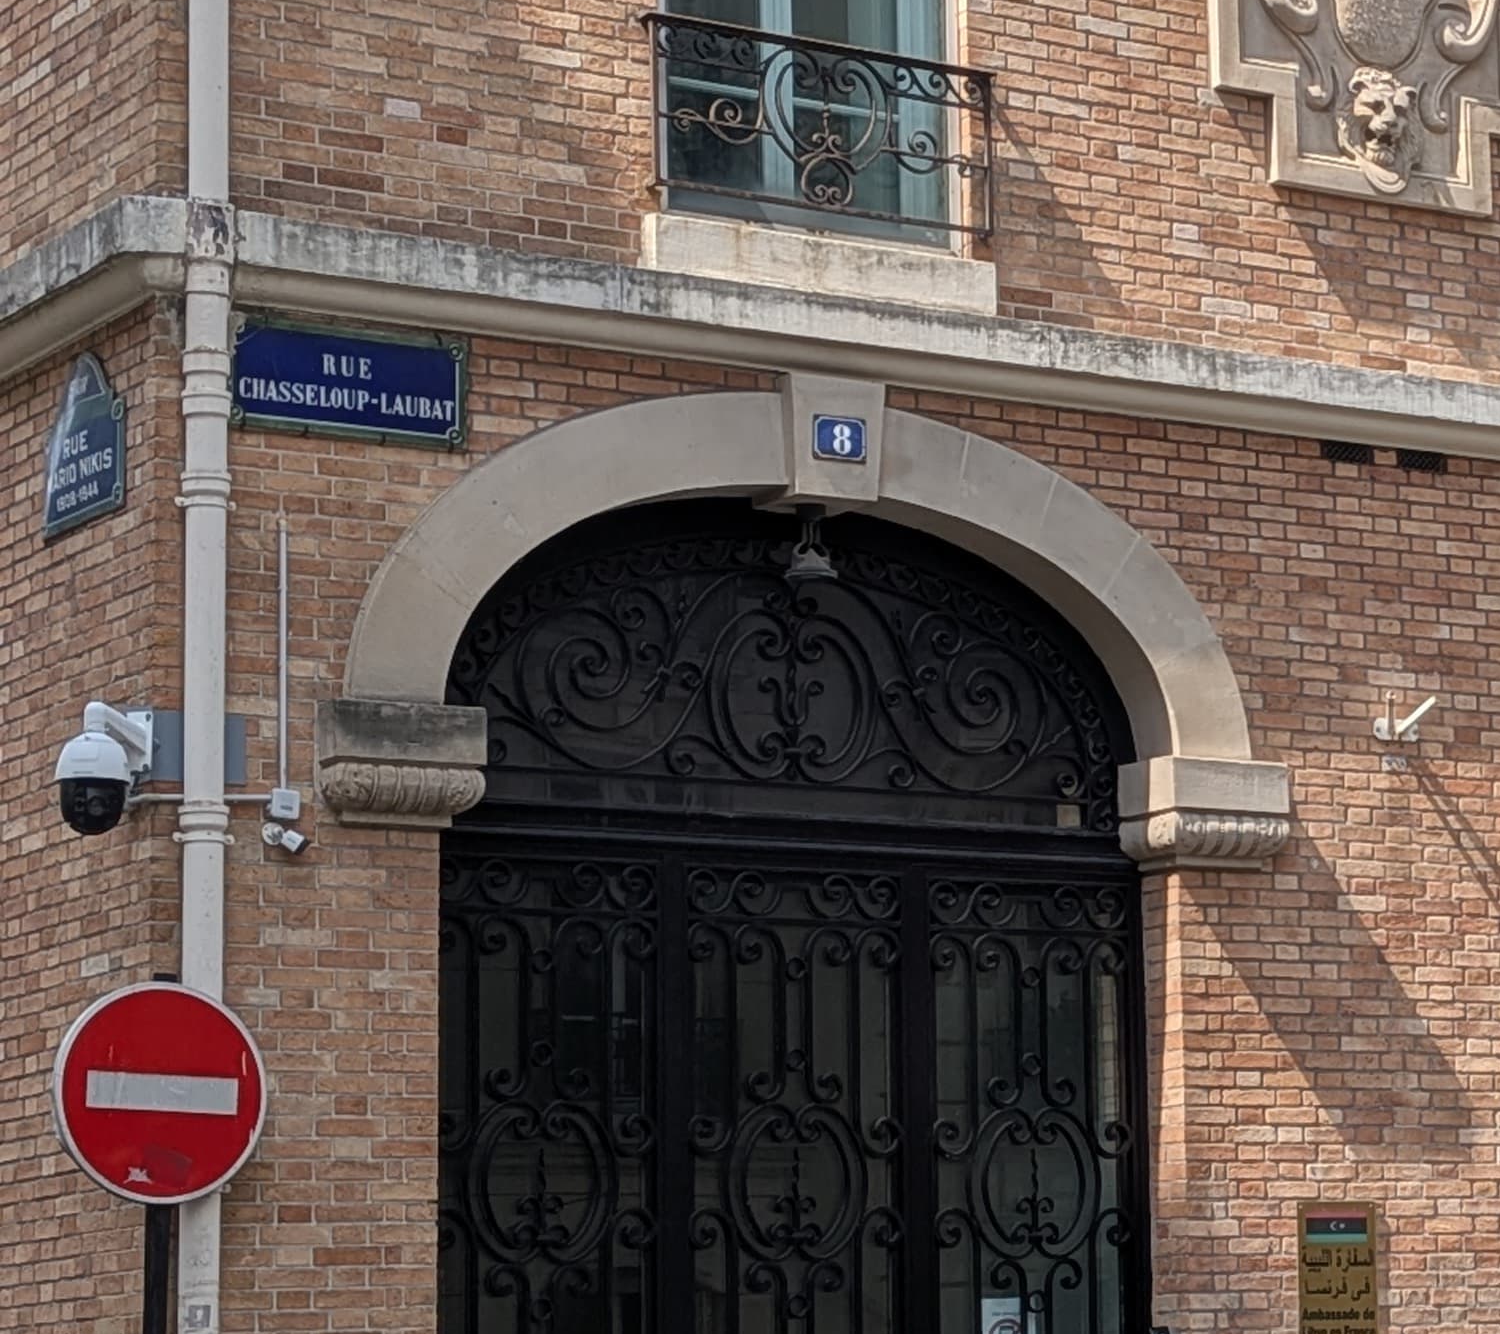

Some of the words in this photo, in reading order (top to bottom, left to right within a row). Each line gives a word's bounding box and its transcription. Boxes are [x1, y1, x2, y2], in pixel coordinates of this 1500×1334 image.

[321, 353, 373, 380] RUE
[238, 377, 455, 422] CHASSELOUP-LAUBAT
[62, 429, 89, 460] RUE
[832, 423, 852, 455] 8
[51, 462, 77, 491] ARIO
[79, 447, 113, 480] NIKIS
[1302, 1307, 1360, 1321] Ambassade
[1363, 1307, 1376, 1321] de
